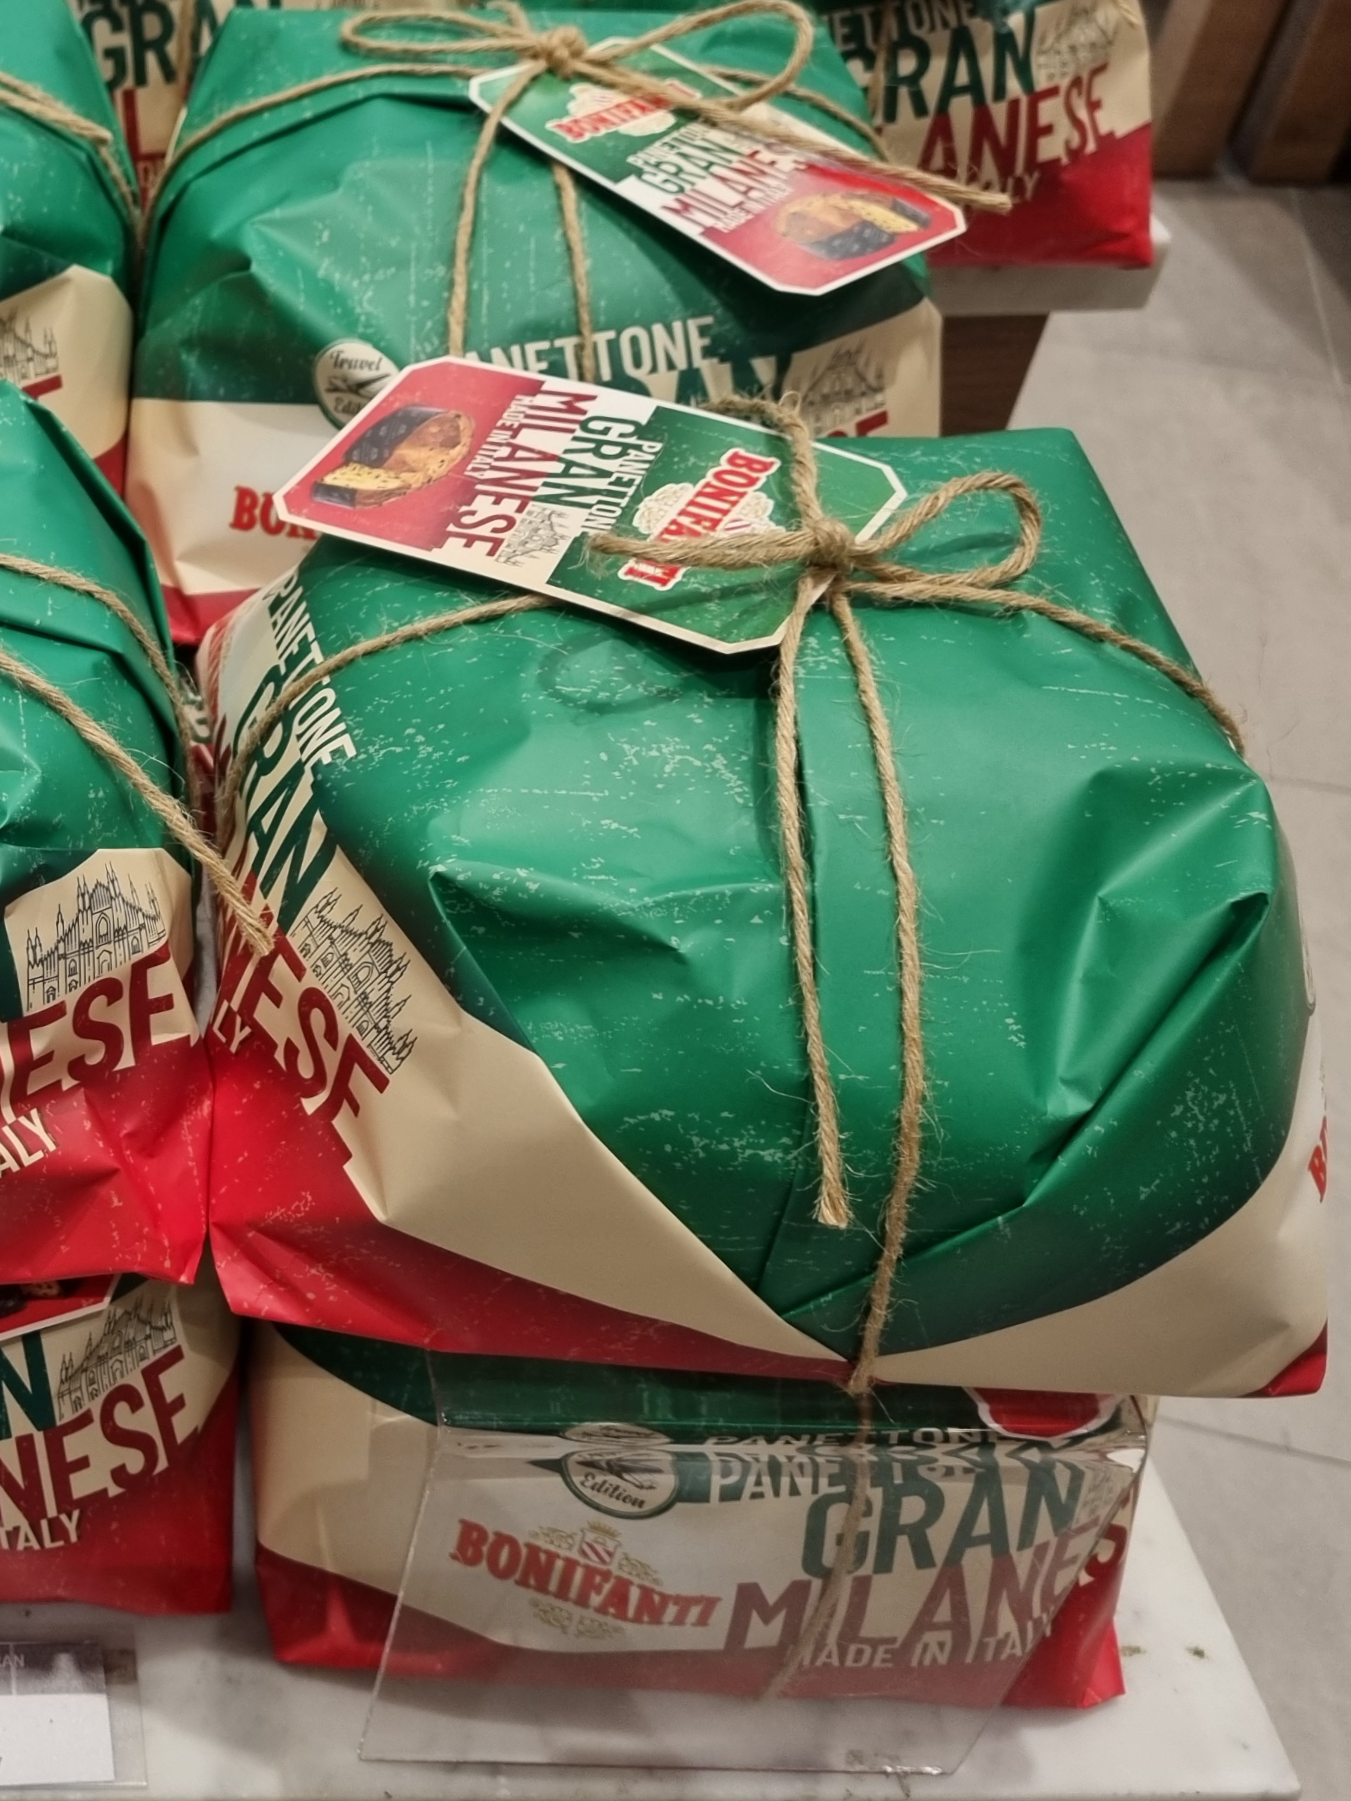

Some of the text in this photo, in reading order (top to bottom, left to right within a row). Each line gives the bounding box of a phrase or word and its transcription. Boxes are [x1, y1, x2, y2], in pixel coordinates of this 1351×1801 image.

[917, 62, 1109, 172] ANESE
[639, 136, 745, 195] GRAN
[660, 142, 806, 235] MILANE
[330, 350, 383, 372] Travel
[495, 394, 536, 429] MADE
[447, 389, 598, 558] MILANESE
[463, 443, 505, 480] ITALY
[532, 415, 645, 510] GRAN
[580, 439, 664, 534] PANETTON
[579, 1470, 646, 1510] Edition
[801, 1447, 1086, 1581] GRAN
[450, 1517, 723, 1628] BONIFANTI
[911, 1637, 951, 1668] IN
